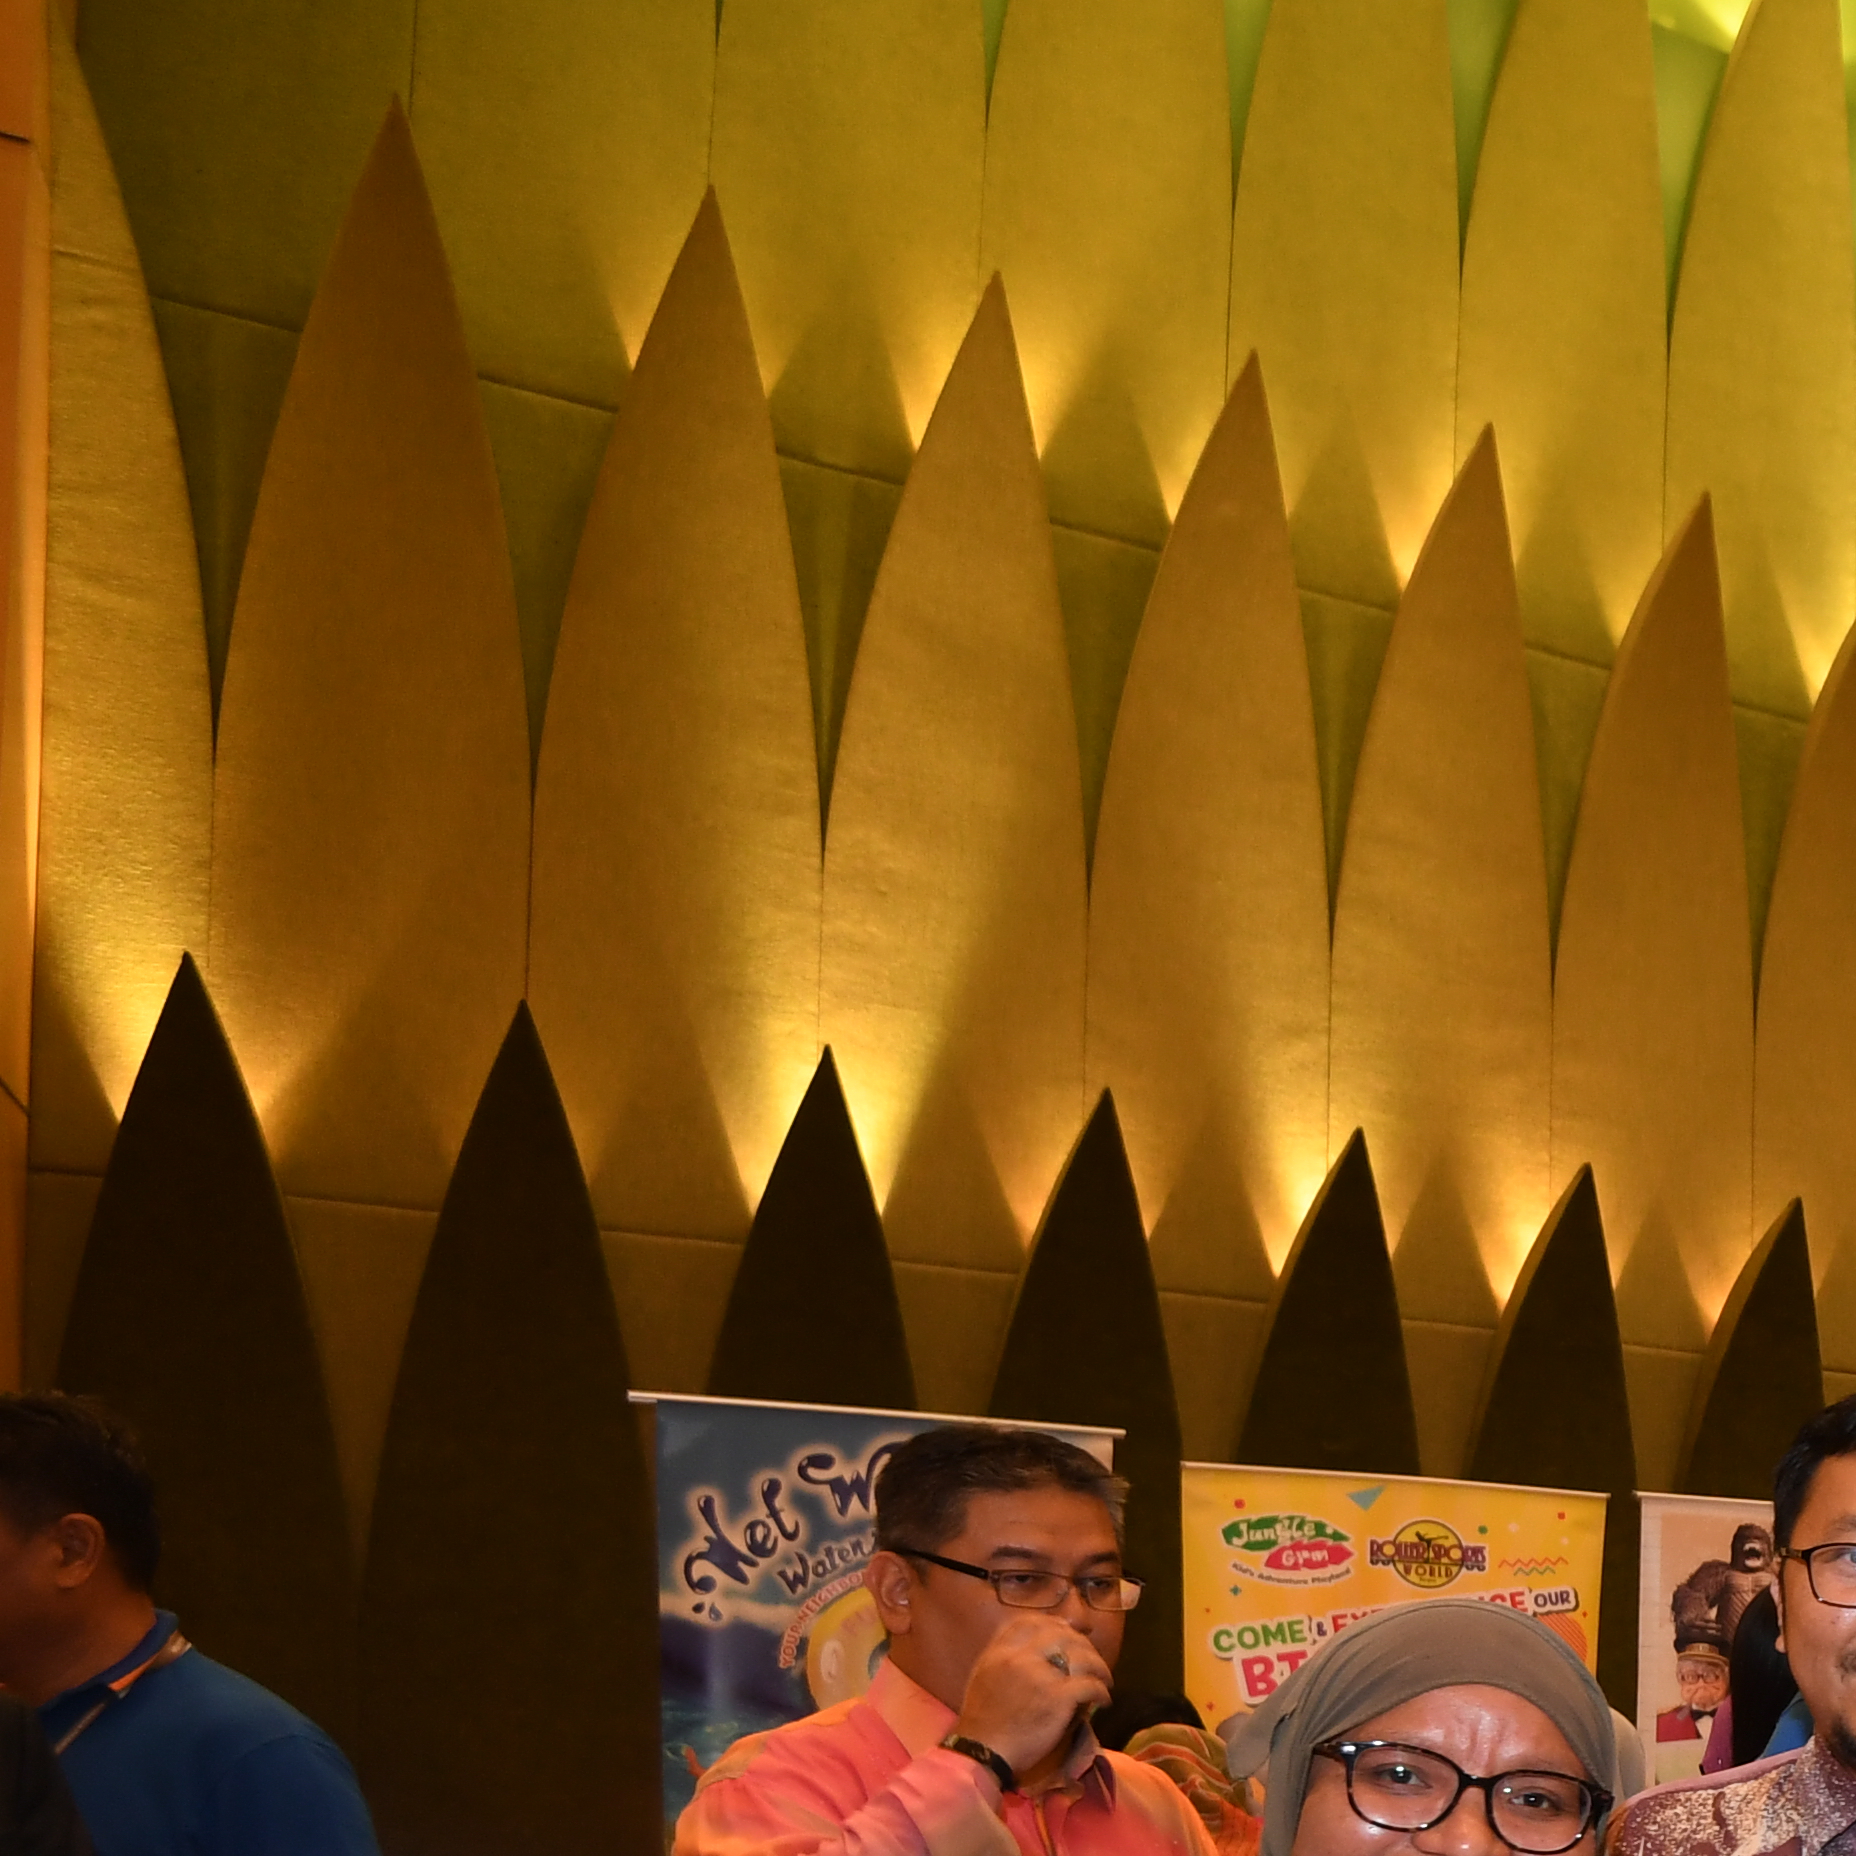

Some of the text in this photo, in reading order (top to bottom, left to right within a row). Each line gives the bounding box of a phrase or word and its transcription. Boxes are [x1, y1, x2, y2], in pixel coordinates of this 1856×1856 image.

[684, 1478, 800, 1595] Wet
[1534, 1590, 1572, 1608] OUR
[1213, 1619, 1327, 1653] COME &
